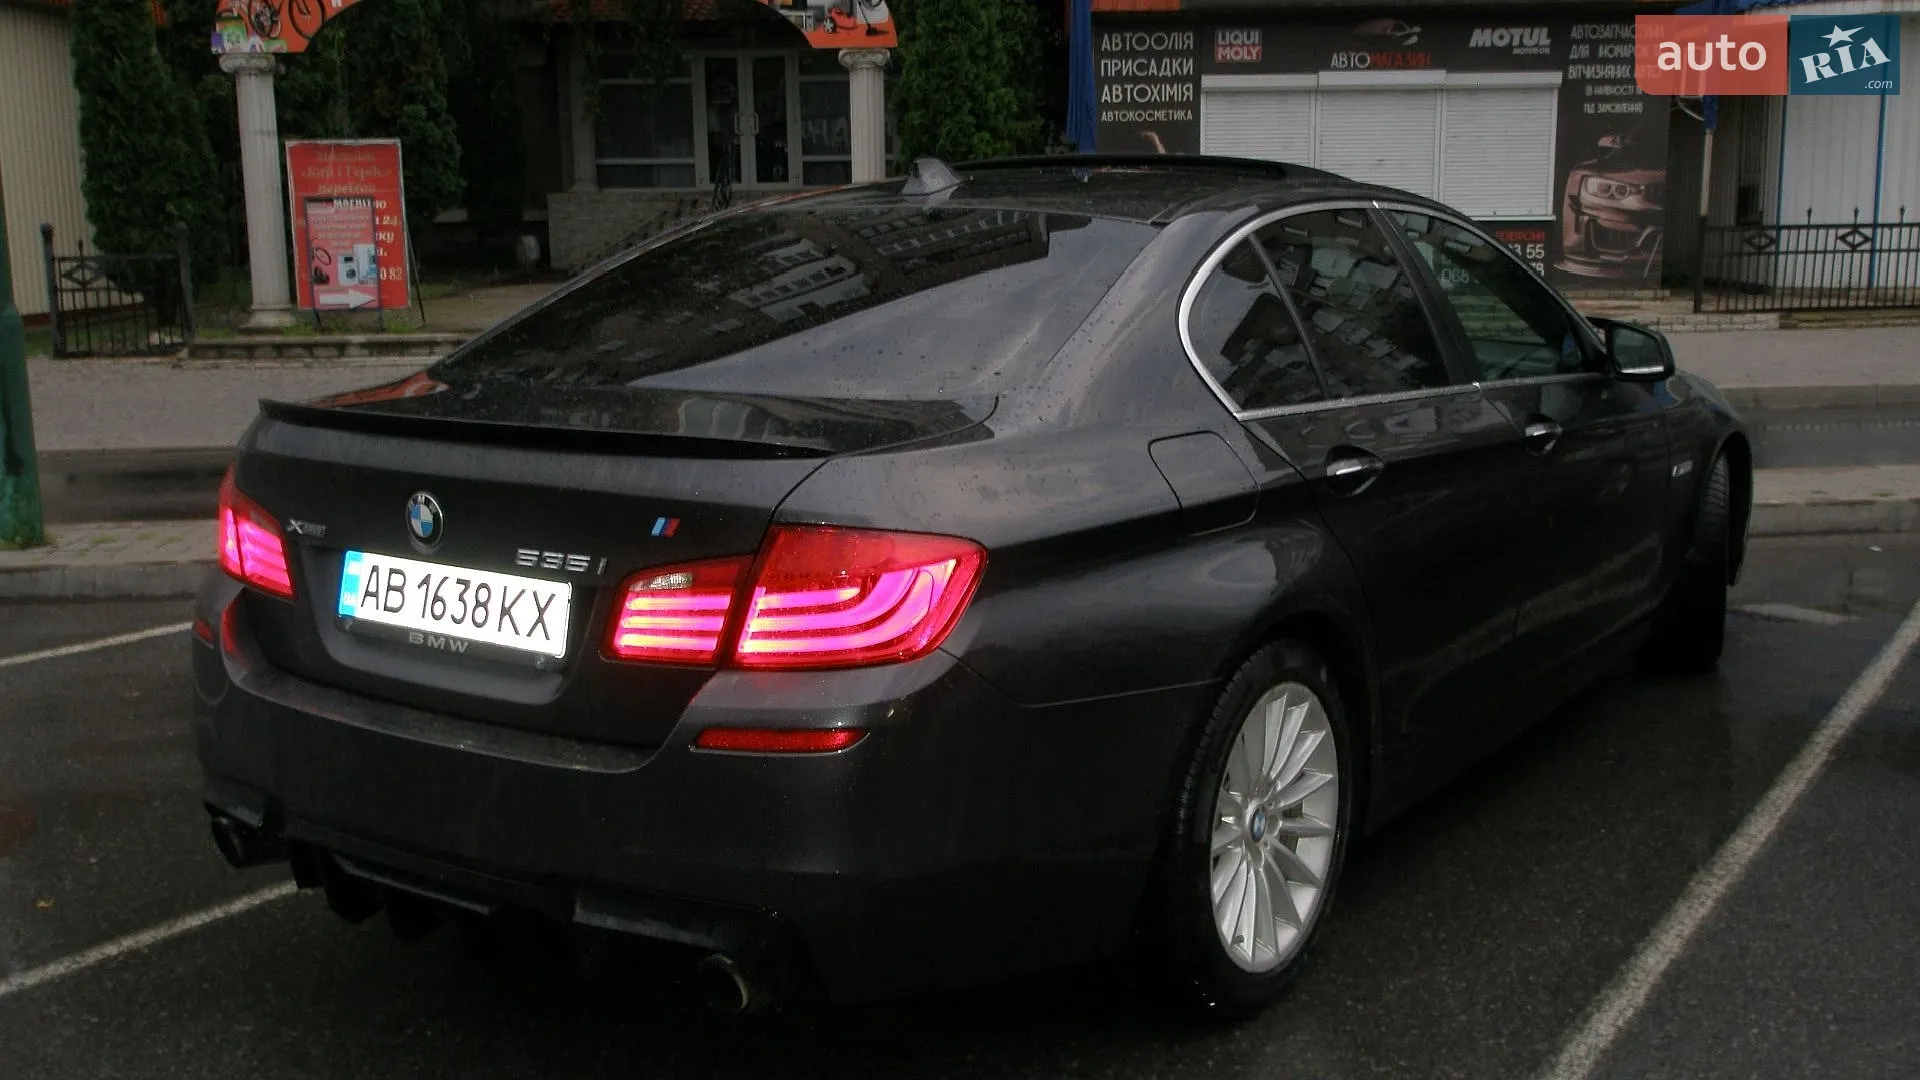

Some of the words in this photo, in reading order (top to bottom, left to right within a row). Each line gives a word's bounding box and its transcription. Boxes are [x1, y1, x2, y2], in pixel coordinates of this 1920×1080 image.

[1100, 32, 1194, 51] АВТООЛІЯ
[1217, 30, 1260, 45] LIQUI
[1469, 26, 1552, 47] MOTUL
[1217, 46, 1261, 60] MOLY
[1329, 51, 1433, 69] АВТОМАГАЗИН
[1569, 44, 1590, 60] ДЛЯ
[1100, 57, 1193, 77] ПРИСАДКИ
[1100, 82, 1193, 103] АВТОХІМІЯ
[1100, 108, 1193, 122] АВТОКОСМЕТИКА
[1526, 244, 1545, 260] 55
[361, 564, 407, 614] AB
[417, 573, 492, 629] 1638
[497, 585, 556, 641] KX
[408, 632, 469, 654] BMW
